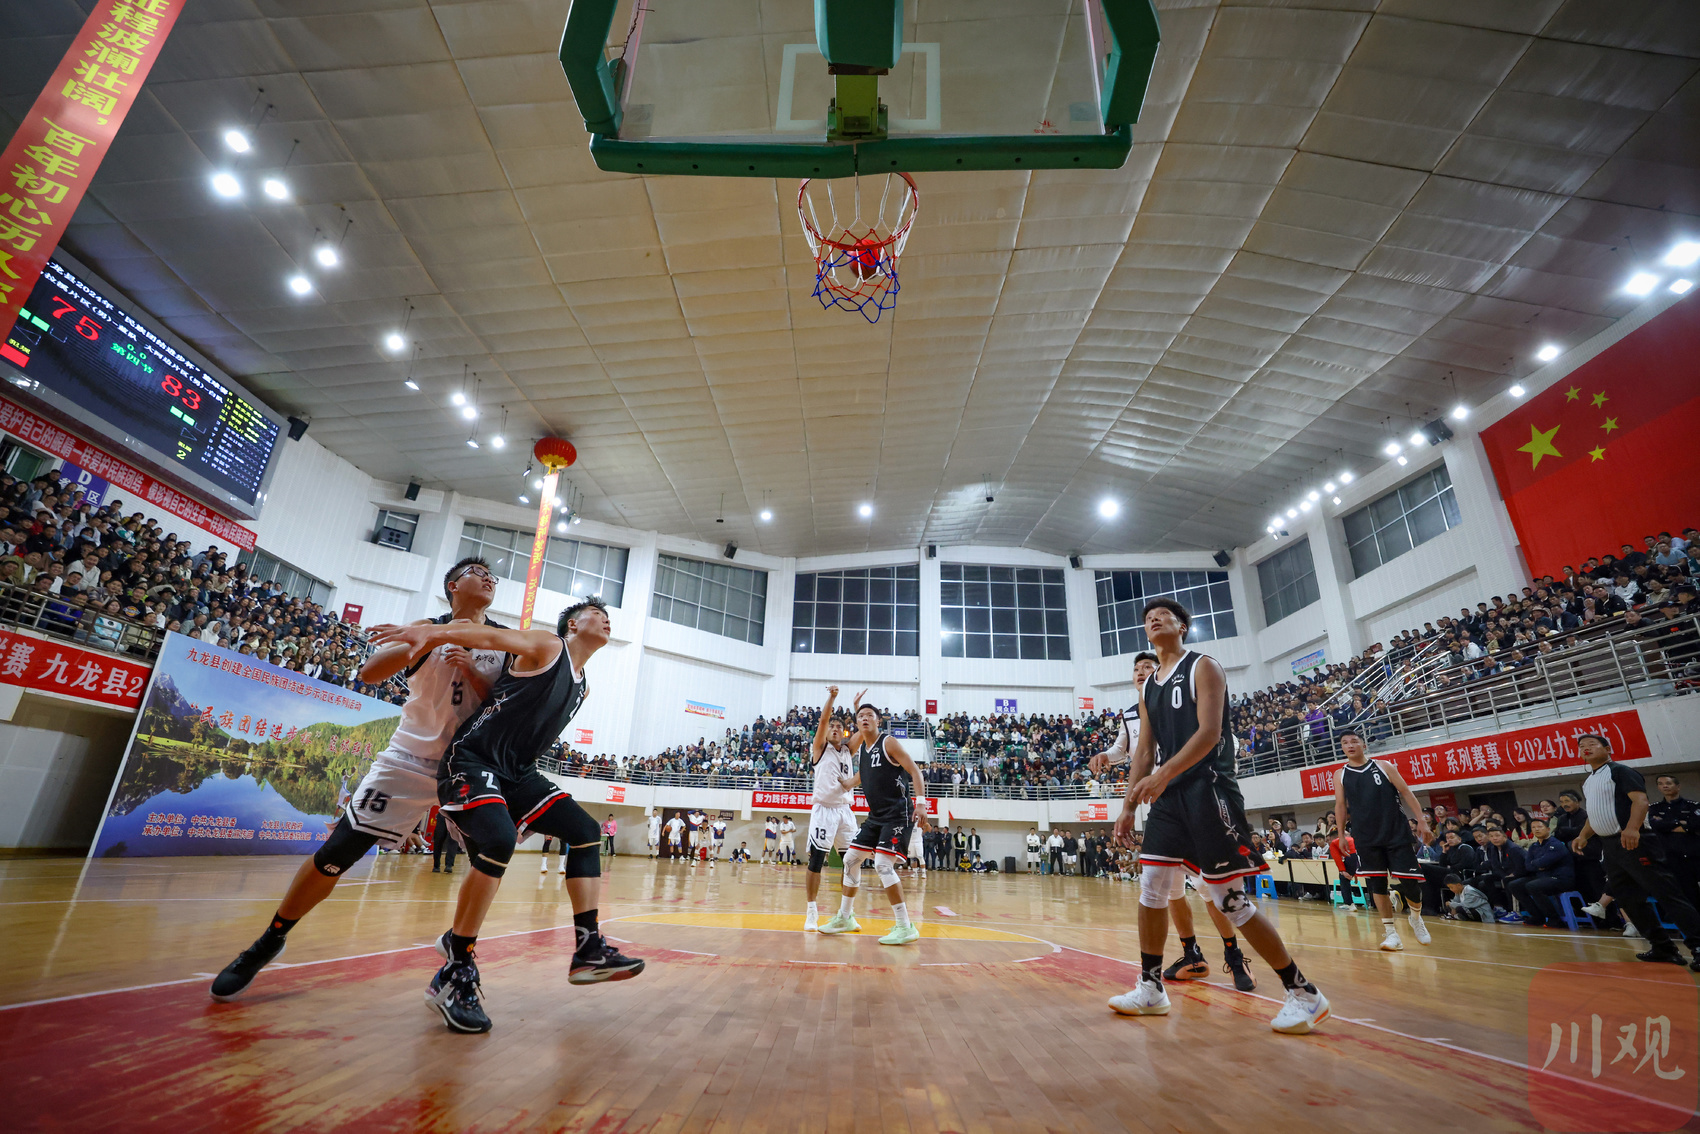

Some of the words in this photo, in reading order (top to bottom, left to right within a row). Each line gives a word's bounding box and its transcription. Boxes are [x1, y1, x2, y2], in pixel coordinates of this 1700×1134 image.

[52, 296, 102, 340] 75
[161, 375, 201, 409] 83
[176, 450, 186, 460] 2
[77, 469, 92, 485] D
[38, 653, 144, 698] 九龙县2
[186, 648, 362, 711] 九龙县创建全国民族团结进步示范区系列活动
[1172, 686, 1183, 709] 0
[871, 753, 881, 767] 22
[481, 771, 499, 791] 2
[1373, 773, 1382, 786] 8
[358, 787, 392, 814] 15
[815, 827, 827, 840] 13
